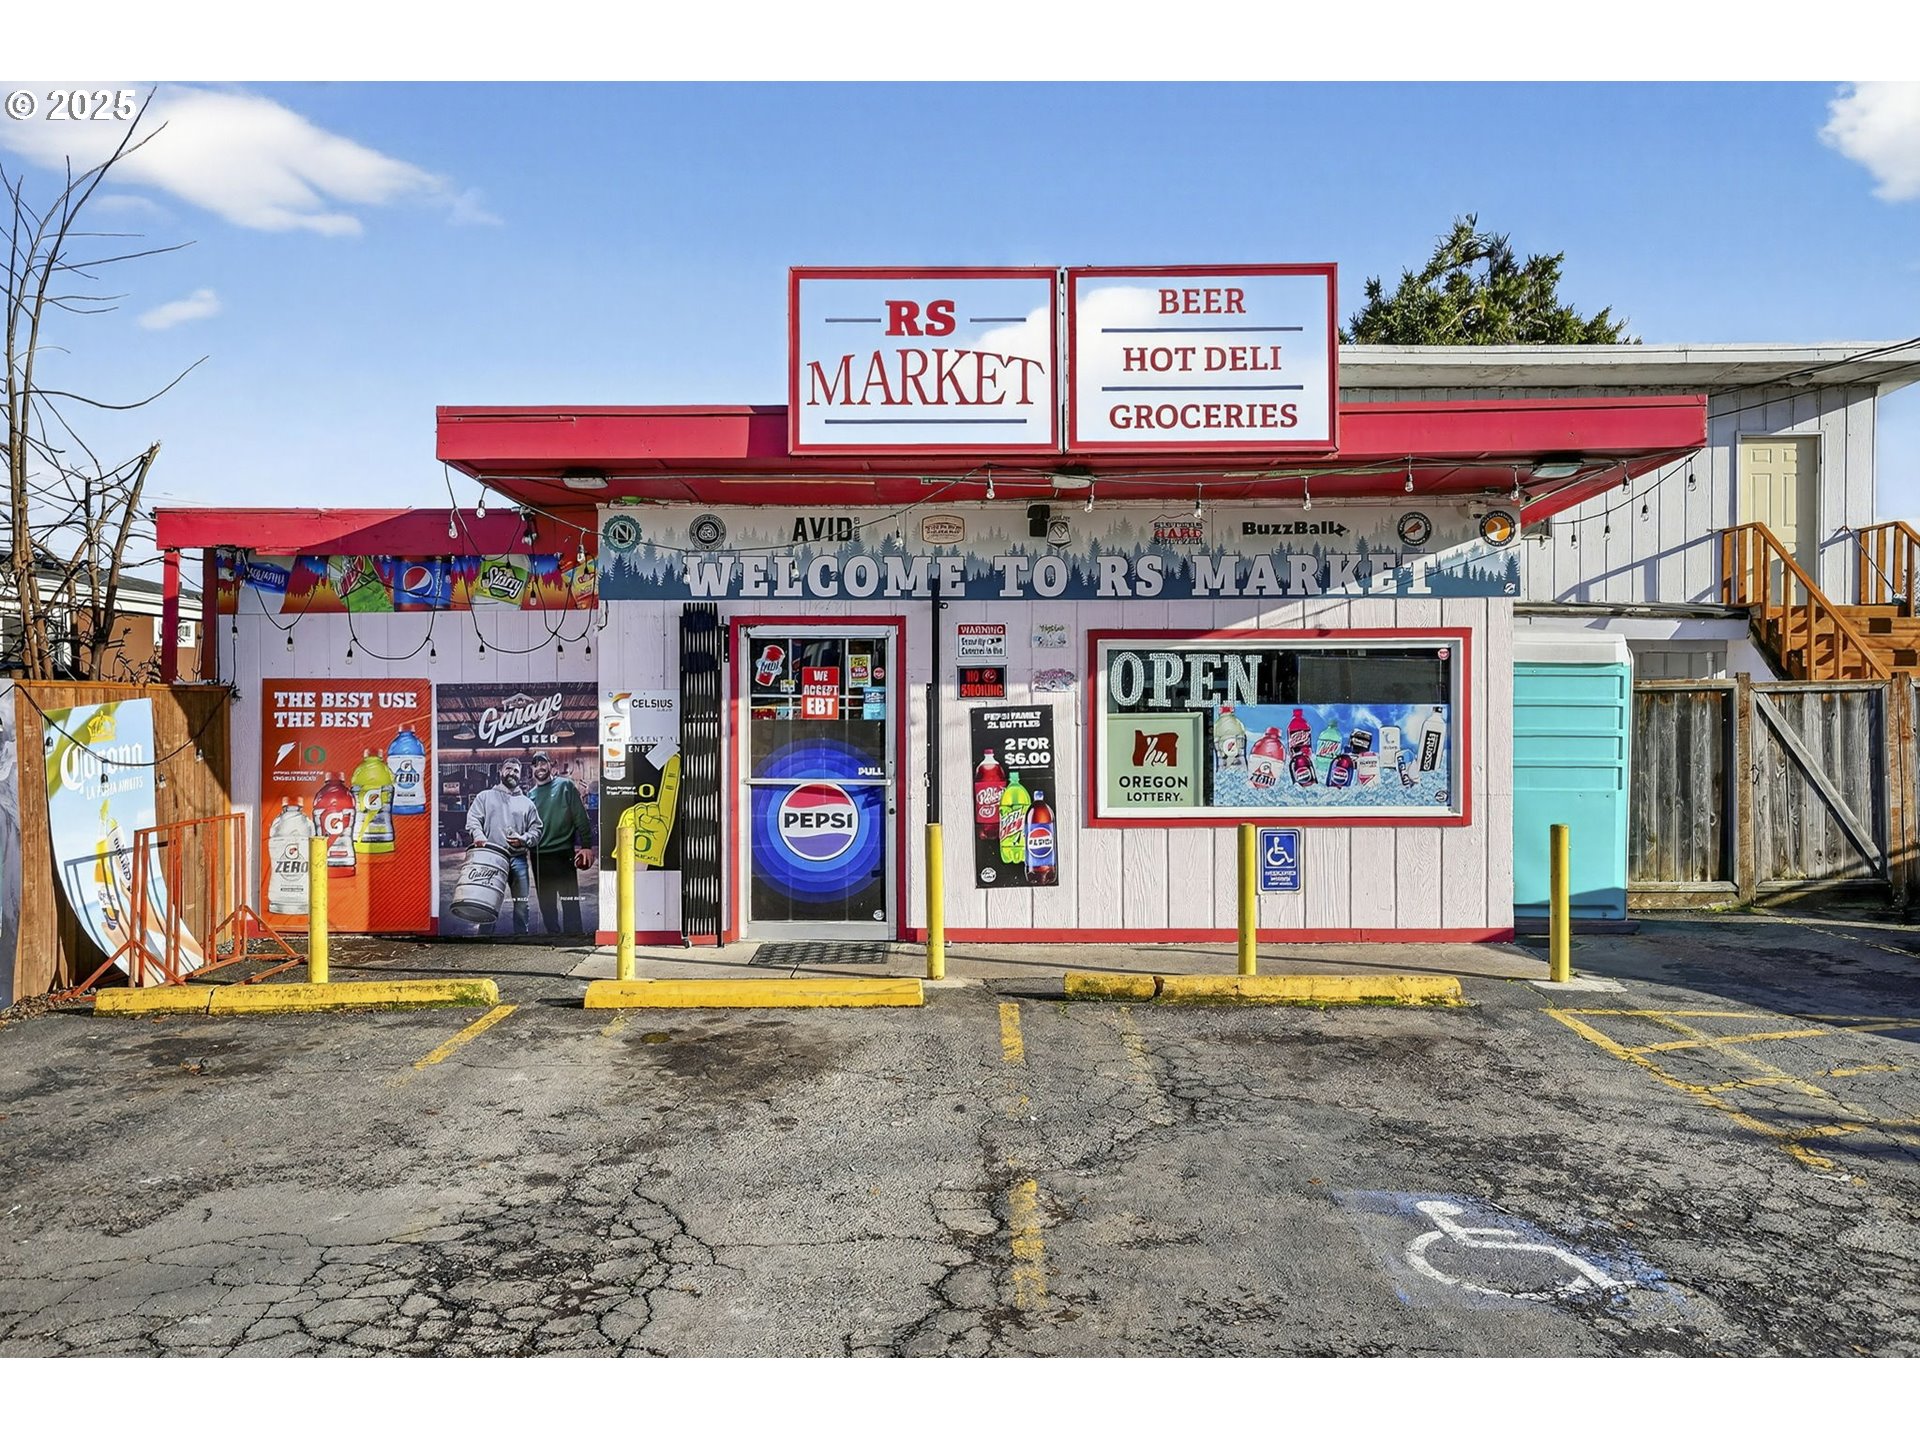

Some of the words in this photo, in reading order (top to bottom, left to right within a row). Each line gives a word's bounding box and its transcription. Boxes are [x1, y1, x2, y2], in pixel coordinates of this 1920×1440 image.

[1158, 288, 1247, 314] BEER
[885, 299, 956, 337] RS
[1122, 346, 1196, 372] HOT
[1204, 346, 1282, 372] DELI
[806, 348, 1045, 406] MARKET
[1109, 403, 1298, 429] GROCERIES
[792, 516, 853, 542] AVID
[682, 555, 966, 598] WELCOME
[993, 555, 1069, 598] TO
[1096, 555, 1164, 598] RS
[1191, 553, 1437, 597] MARKET
[960, 625, 1004, 634] WARNING
[813, 670, 829, 681] WE
[1110, 651, 1263, 708] OPEN
[803, 685, 839, 696] ACCEPT
[273, 692, 316, 708] THE
[321, 692, 373, 708] BEST
[378, 692, 417, 708] USE
[631, 698, 673, 709] CELSIUS
[806, 697, 835, 715] EBT
[273, 712, 315, 728] THE
[320, 712, 373, 728] BEST
[478, 692, 562, 743] Garage
[1004, 738, 1016, 750] 2
[1017, 737, 1049, 750] FOR
[1004, 751, 1051, 765] $6.00
[60, 741, 144, 795] Corona
[858, 767, 884, 776] PULL
[1119, 776, 1188, 788] OREGON
[784, 813, 853, 828] PEPSI
[275, 861, 309, 874] ZERO
